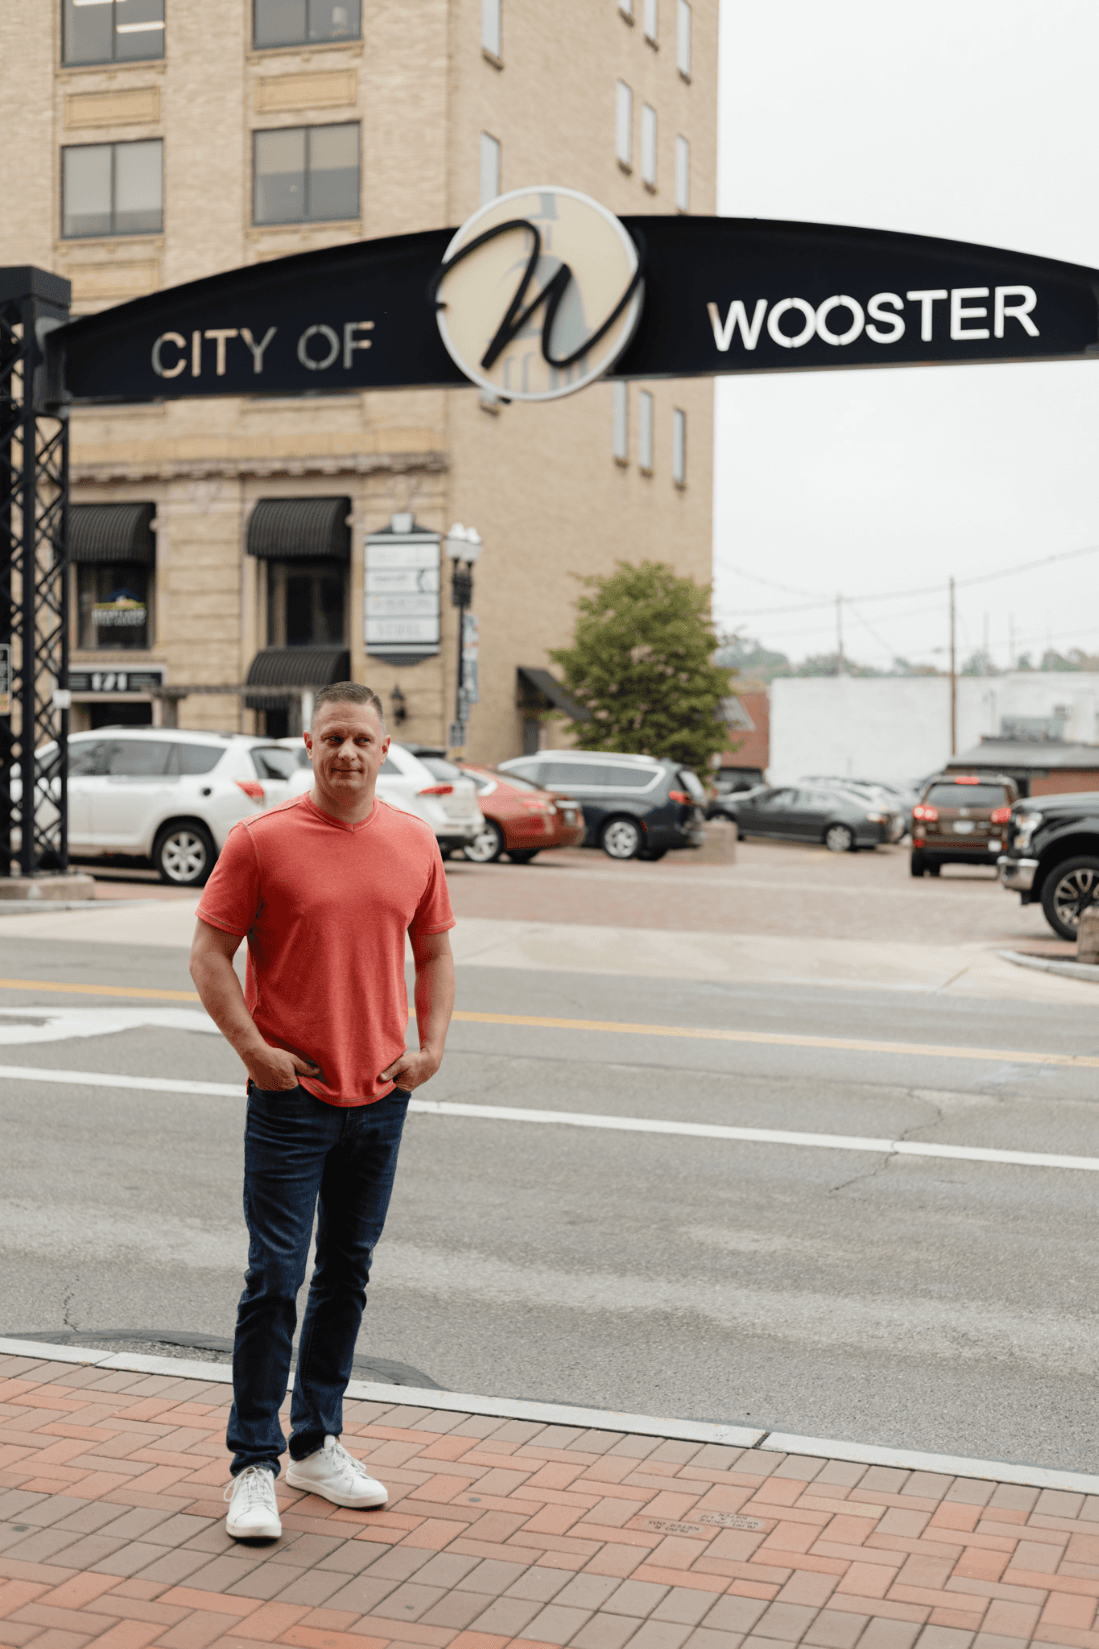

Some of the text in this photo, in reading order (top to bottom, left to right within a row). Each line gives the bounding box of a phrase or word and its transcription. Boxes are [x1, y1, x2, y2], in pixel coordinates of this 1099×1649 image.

[151, 285, 1041, 378] CITY OF WOOSTER
